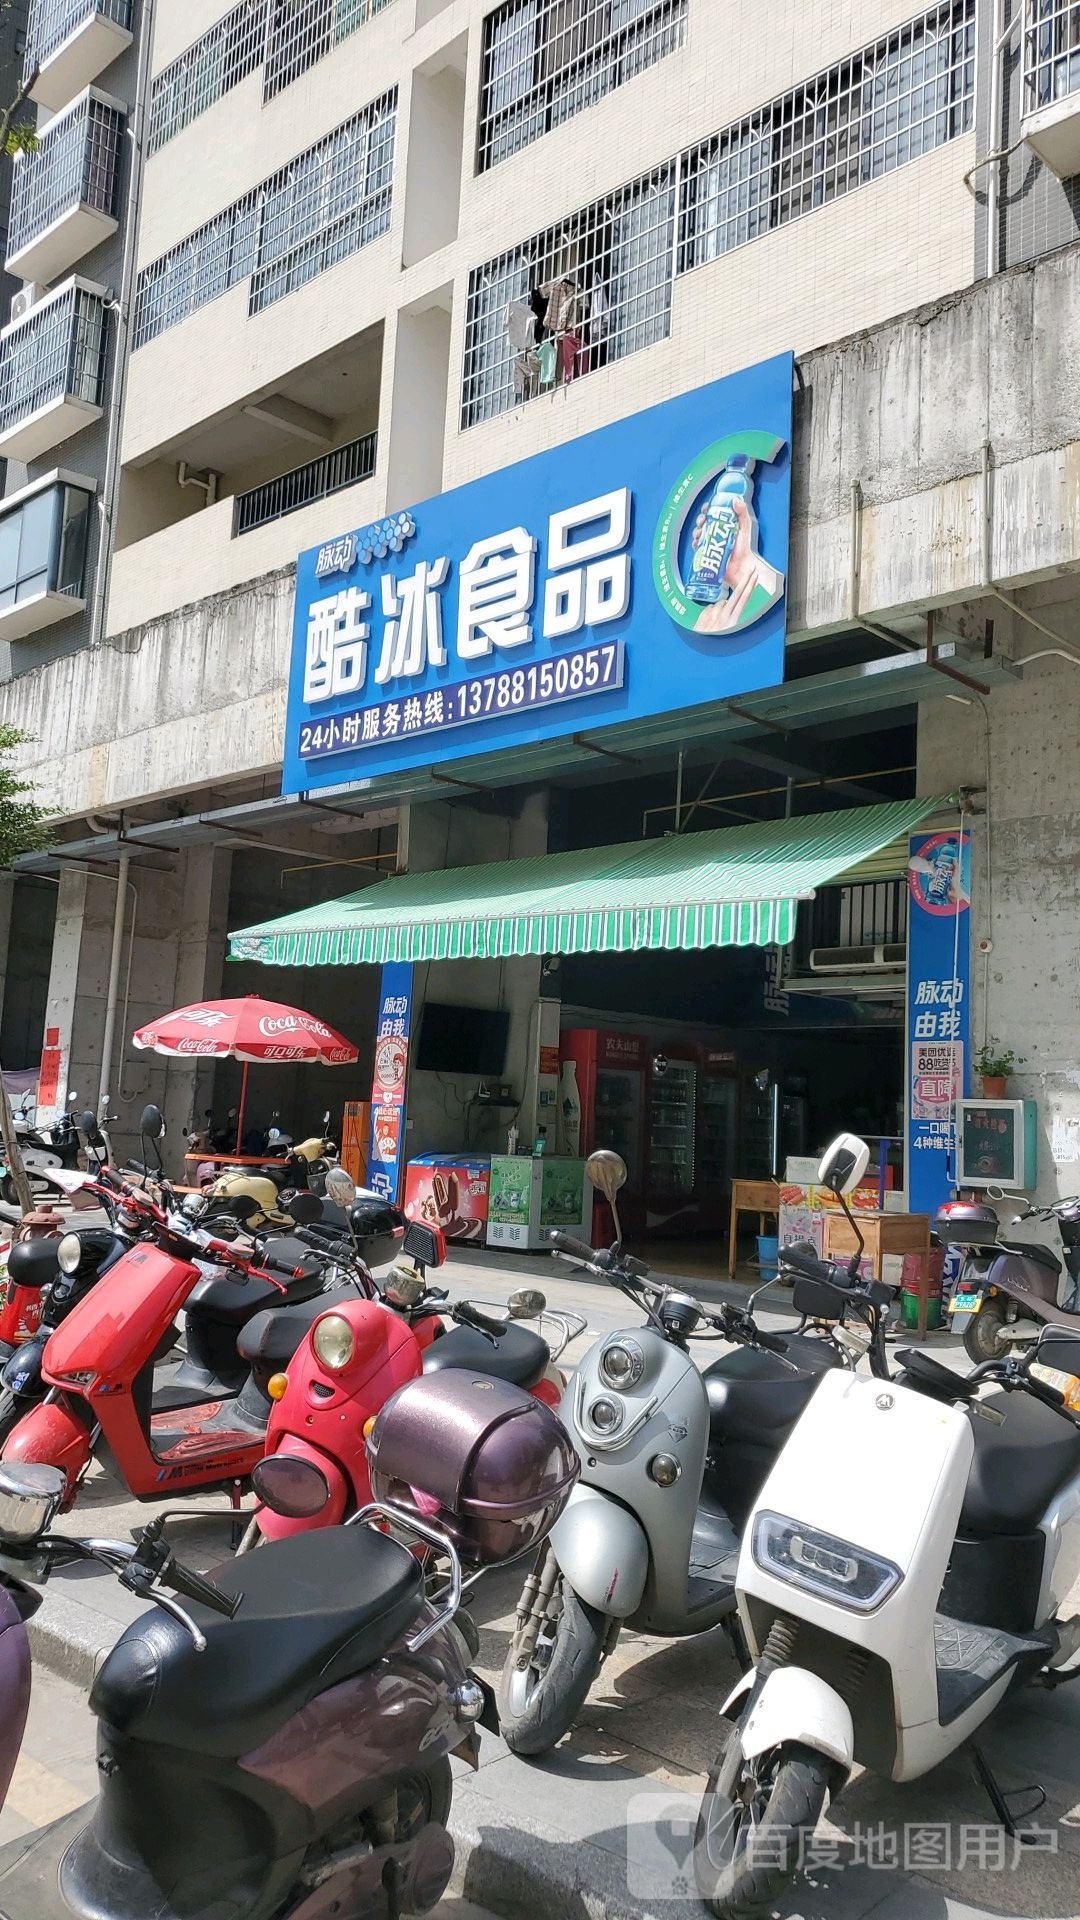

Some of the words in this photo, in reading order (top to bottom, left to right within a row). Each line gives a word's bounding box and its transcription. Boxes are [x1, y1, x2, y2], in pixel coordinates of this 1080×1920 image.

[314, 534, 353, 574] 脉动
[303, 487, 632, 705] 酷冰食品
[300, 645, 616, 753] 24小时服务热线:13788150857
[382, 996, 408, 1017] 脉动
[914, 978, 964, 1009] 脉动
[381, 1018, 405, 1037] 由我
[914, 1011, 961, 1038] 由我
[264, 1045, 307, 1059] 可口可乐
